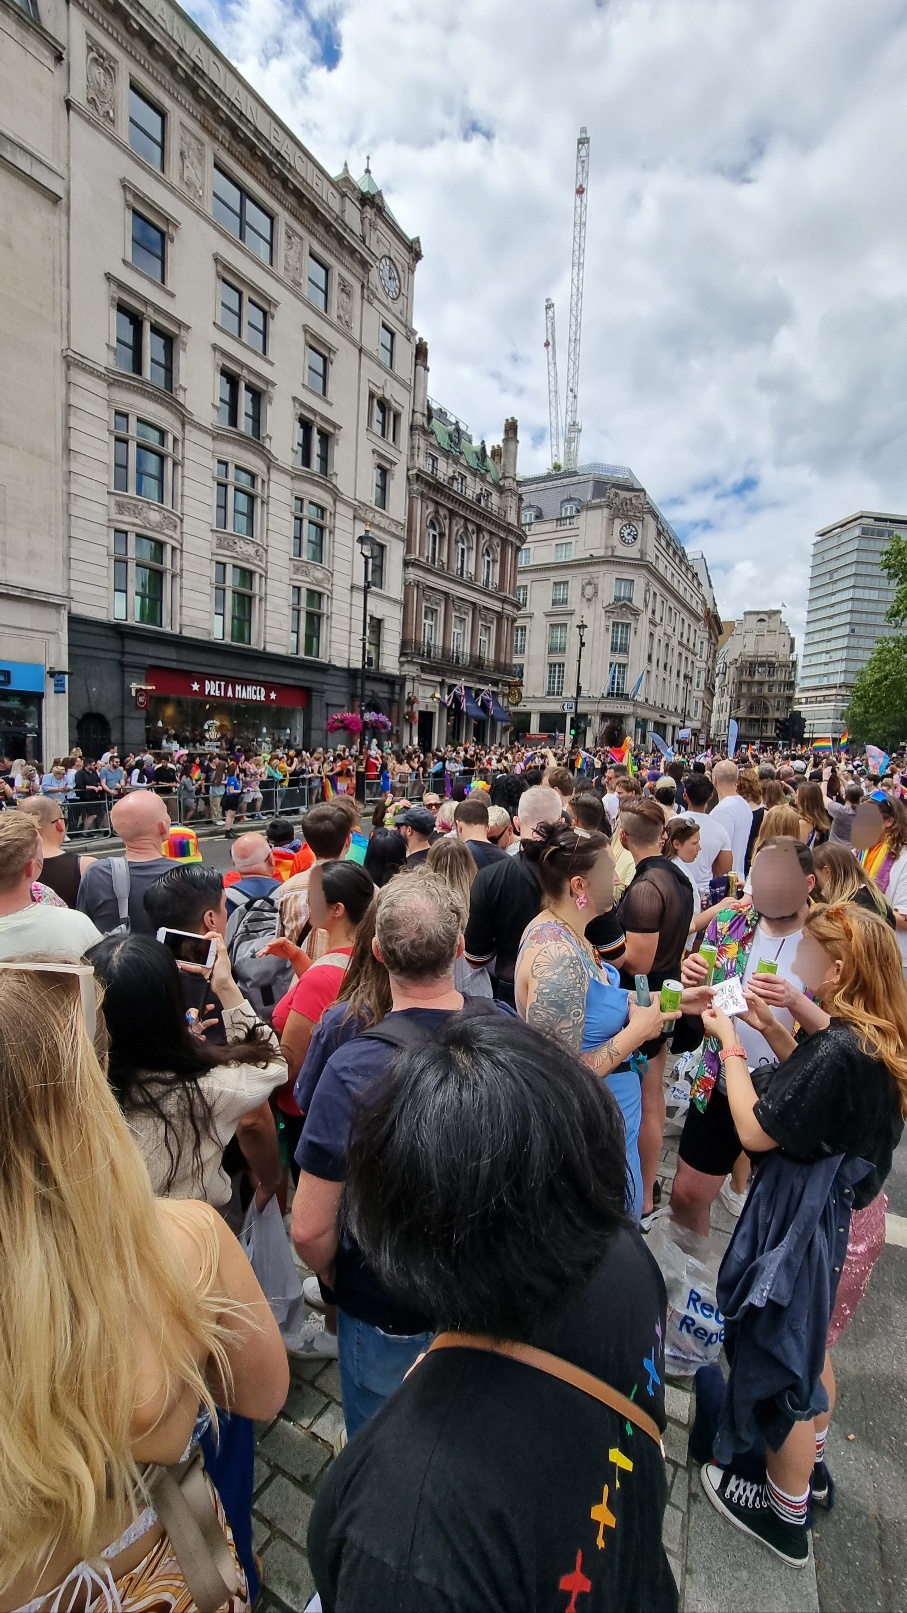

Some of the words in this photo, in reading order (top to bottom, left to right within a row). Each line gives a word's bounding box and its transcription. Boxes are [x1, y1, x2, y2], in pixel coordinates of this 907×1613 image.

[205, 680, 225, 696] PRET
[227, 684, 233, 698] A
[236, 684, 266, 700] MANGER
